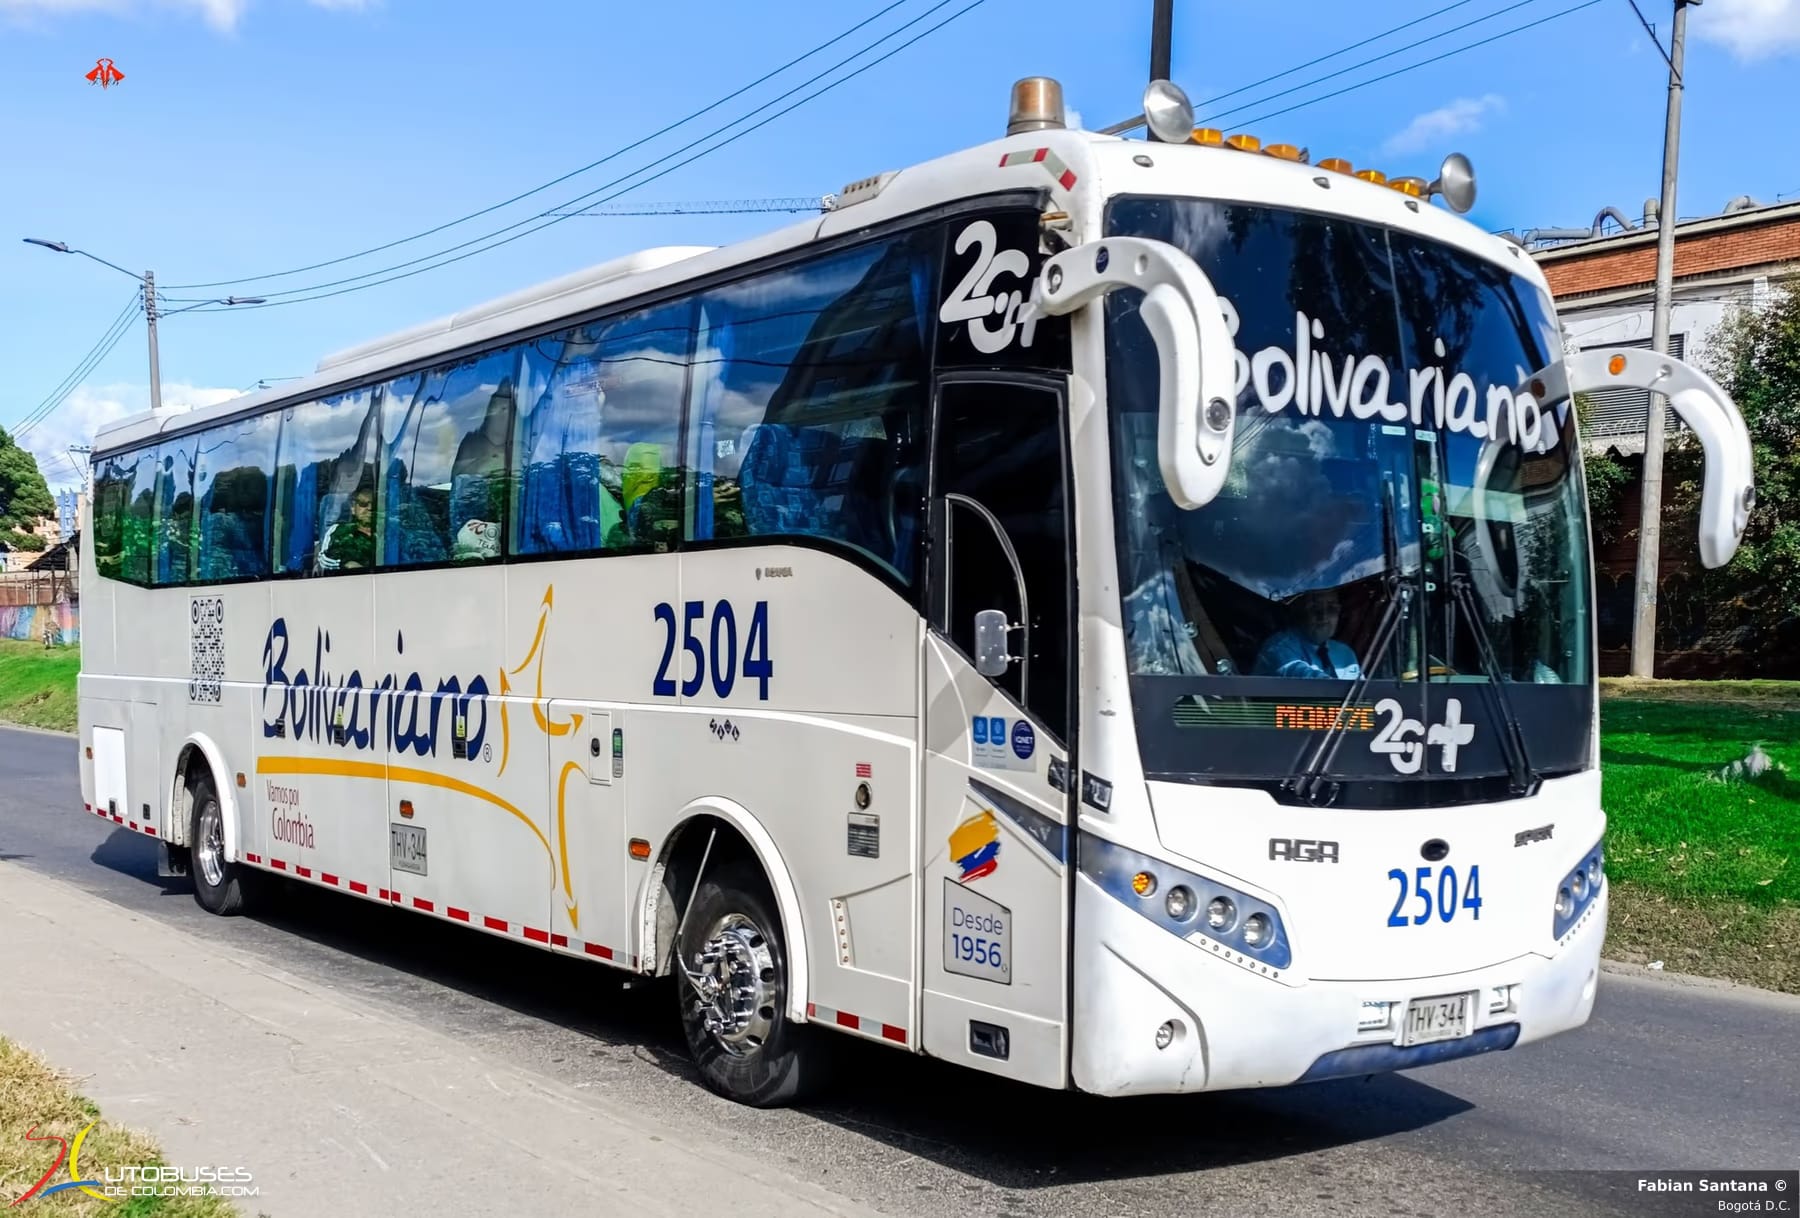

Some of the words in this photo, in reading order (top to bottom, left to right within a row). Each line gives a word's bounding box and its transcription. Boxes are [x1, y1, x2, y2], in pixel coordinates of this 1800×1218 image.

[653, 599, 773, 700] 2504
[263, 617, 489, 761] Bolivariano
[266, 779, 288, 804] Vamos
[272, 807, 315, 848] Colombia
[1269, 838, 1339, 863] AGA
[1387, 865, 1482, 927] 2504
[953, 907, 1003, 935] Desde
[952, 933, 1002, 968] 1956
